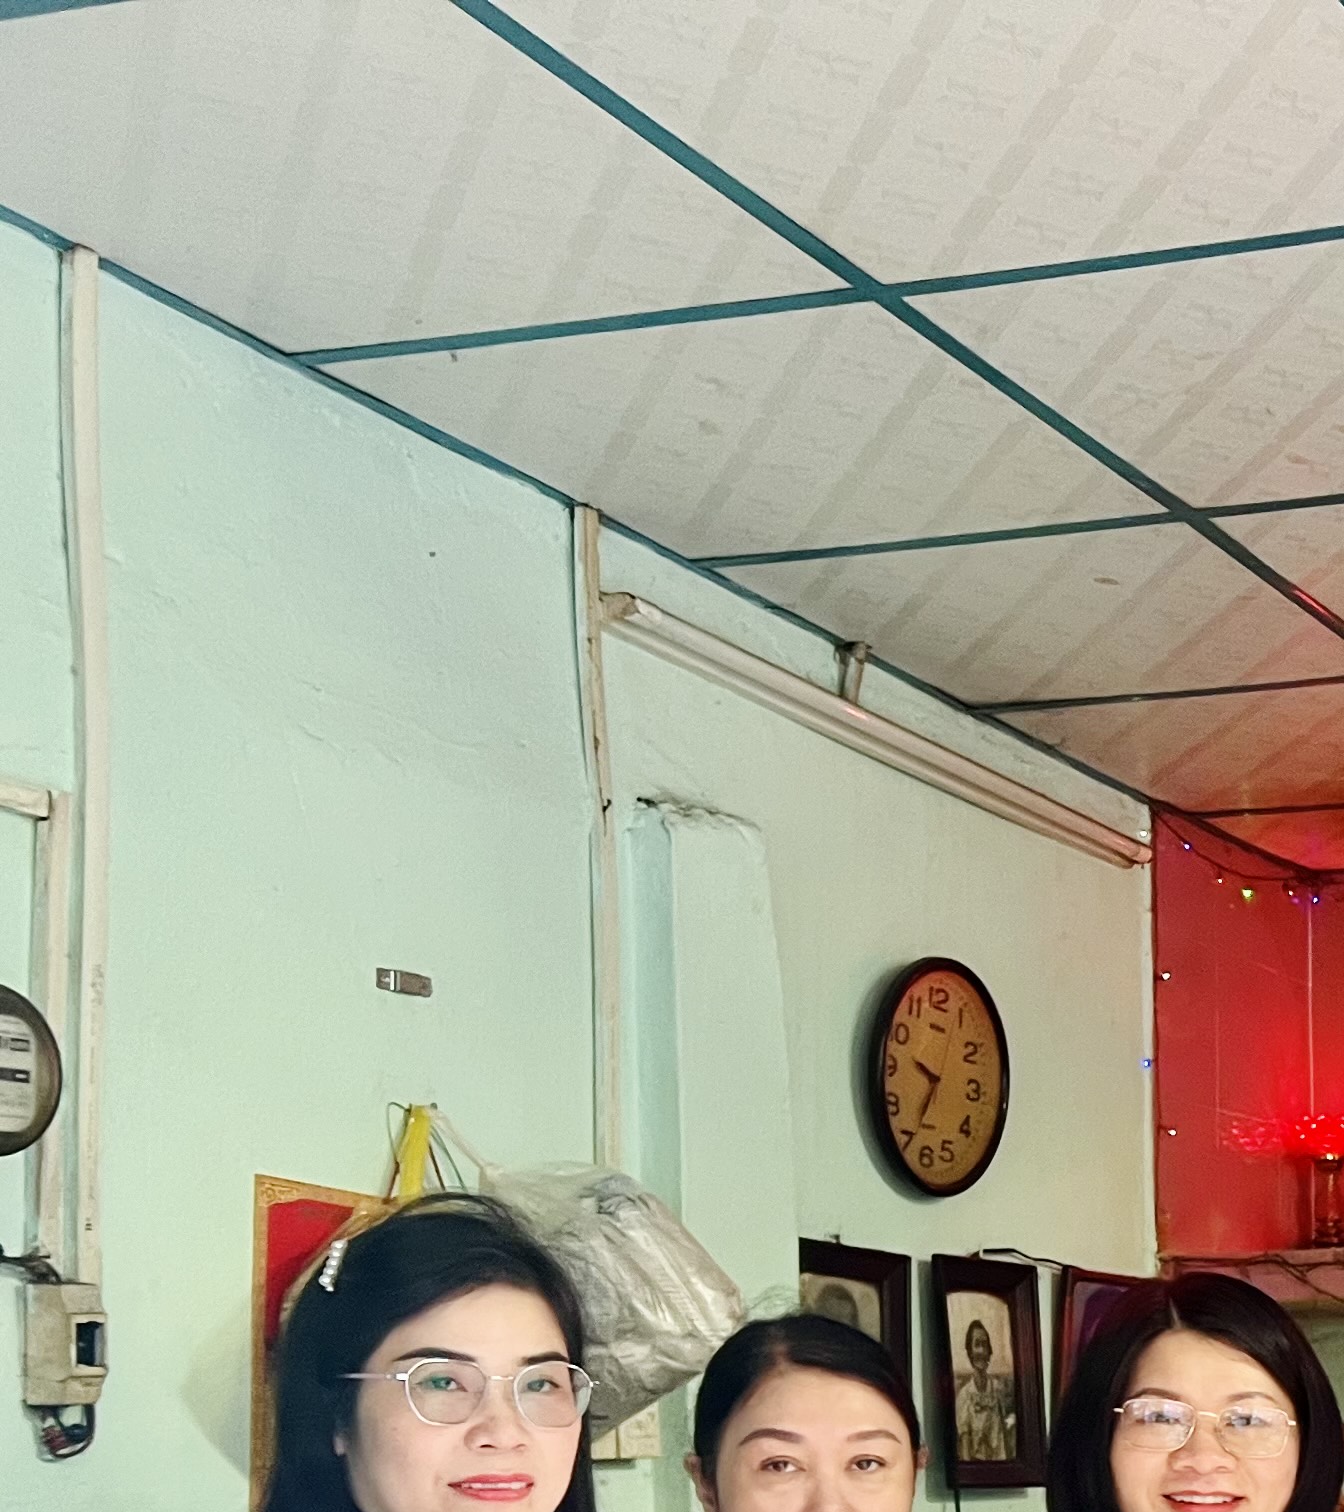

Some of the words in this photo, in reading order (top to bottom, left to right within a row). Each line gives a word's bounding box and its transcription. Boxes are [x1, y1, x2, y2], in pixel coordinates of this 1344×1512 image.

[908, 994, 922, 1018] 11
[928, 986, 949, 1013] 12
[958, 1007, 964, 1029] 1
[963, 1041, 978, 1064] 2
[966, 1079, 981, 1103] 3
[959, 1114, 971, 1138] 4
[900, 1130, 916, 1150] 7
[938, 1140, 955, 1163] 5
[919, 1145, 934, 1168] 6
